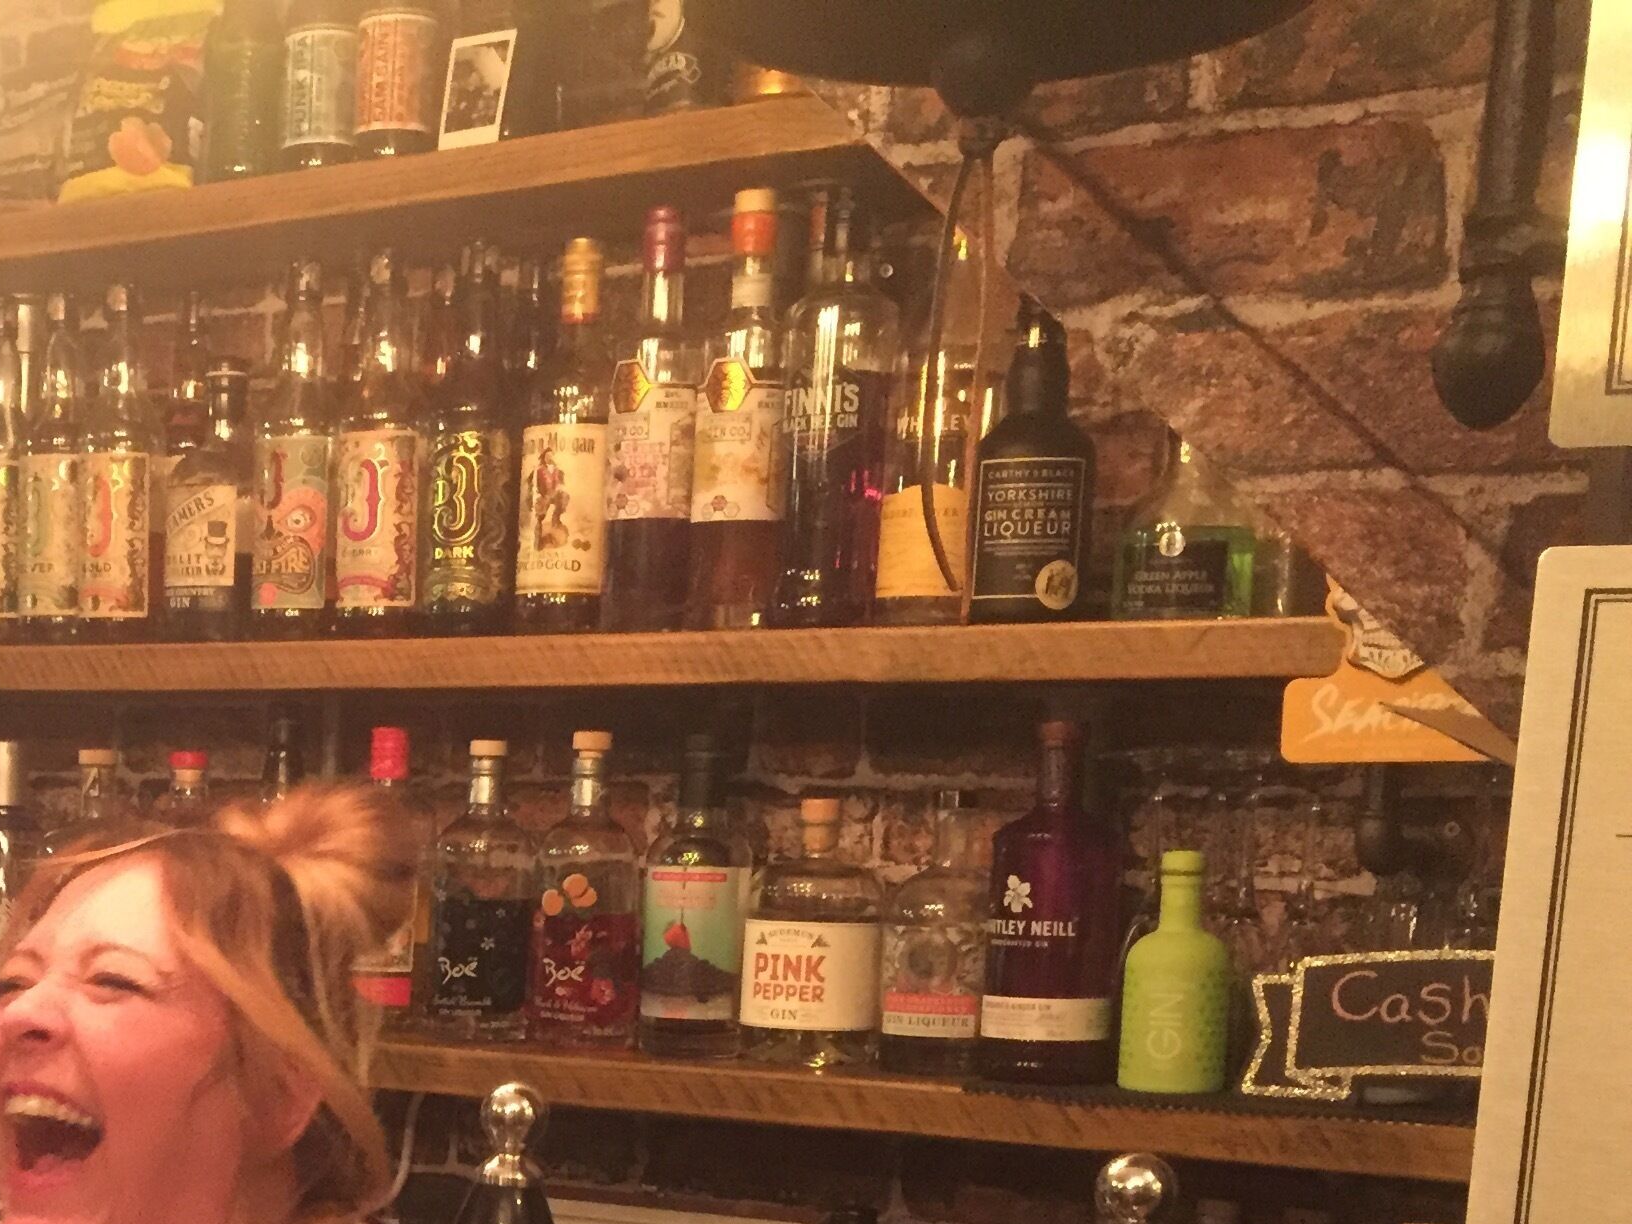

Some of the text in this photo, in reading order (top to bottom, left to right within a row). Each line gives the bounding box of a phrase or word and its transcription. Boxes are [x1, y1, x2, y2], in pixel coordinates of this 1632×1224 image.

[291, 70, 309, 137] PUNK
[836, 413, 859, 429] GIN
[988, 469, 1029, 480] CARTHY
[987, 488, 1073, 502] YORKSHIRE
[171, 491, 215, 527] IMERS
[984, 507, 1071, 522] GIN CREAM
[984, 520, 1072, 538] LIQUEUR
[434, 546, 474, 560] DARK
[1030, 920, 1076, 937] NEILL
[754, 952, 827, 983] PINK
[752, 981, 825, 1003] PEPPER
[1331, 969, 1491, 1026] Cash
[770, 1008, 798, 1021] GIN
[886, 1014, 969, 1028] GIN LIQUEUR
[1146, 991, 1183, 1061] GIN
